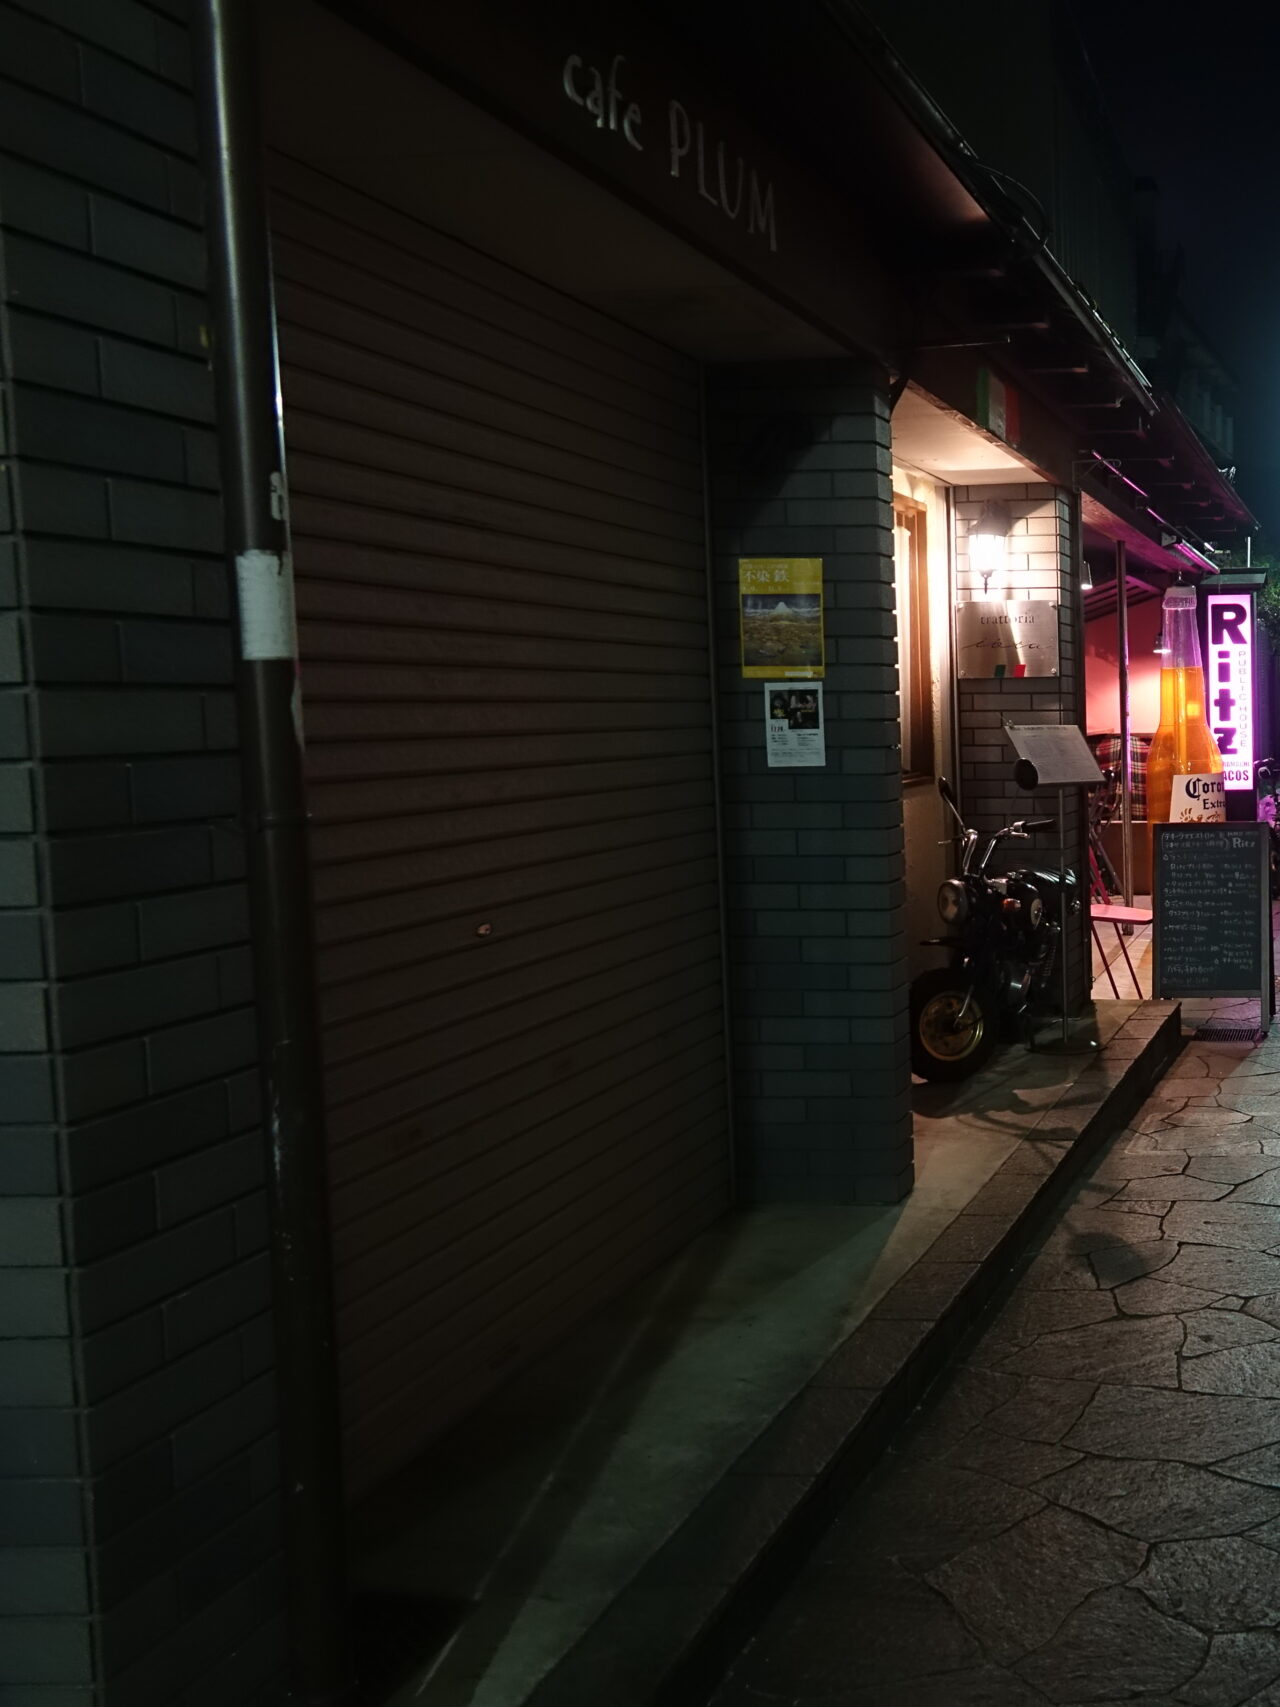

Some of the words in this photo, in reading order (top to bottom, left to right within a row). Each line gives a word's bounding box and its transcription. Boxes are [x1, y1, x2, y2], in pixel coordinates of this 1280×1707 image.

[563, 54, 643, 151] cafe
[669, 99, 778, 252] PLUM
[1211, 603, 1248, 756] Ritz
[1238, 650, 1247, 701] PUBLIC
[1239, 706, 1248, 748] HOUSE
[1185, 777, 1224, 801] Coro
[1223, 769, 1249, 782] ACOS
